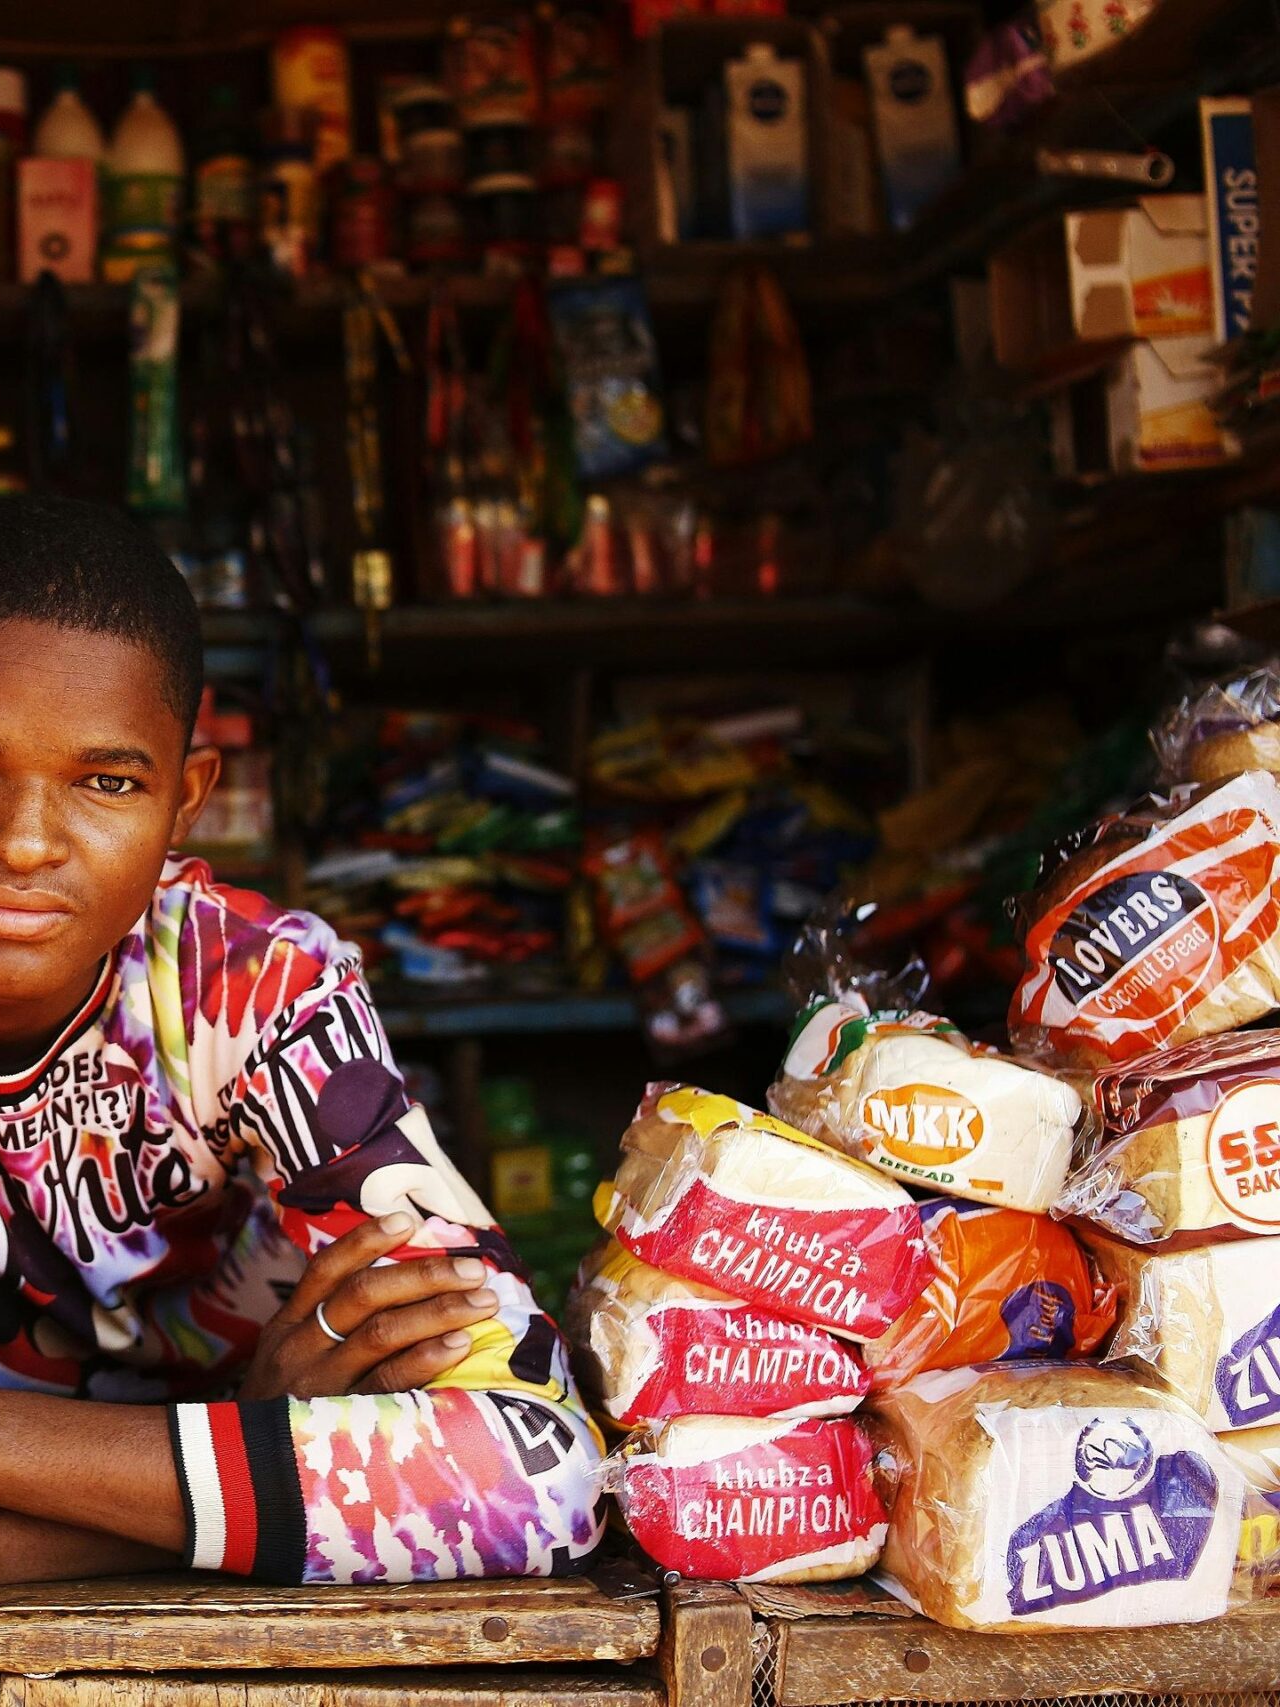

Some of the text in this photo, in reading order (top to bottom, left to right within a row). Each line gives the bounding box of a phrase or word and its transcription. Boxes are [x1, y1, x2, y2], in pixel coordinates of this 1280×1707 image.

[1222, 165, 1260, 281] SUPER
[1056, 874, 1183, 988] LOVERS
[1094, 919, 1210, 1015] Coconut Bread
[868, 1098, 979, 1150] MKK
[878, 1156, 956, 1185] BREAD
[1236, 1168, 1280, 1199] BAK
[745, 1208, 863, 1278] khubza
[690, 1229, 868, 1327] CHAMPION
[725, 1312, 838, 1344] khub
[684, 1343, 862, 1389] CHAMPION
[715, 1458, 834, 1490] khubza
[681, 1494, 852, 1541] CHAMPION
[1016, 1503, 1175, 1602] ZUMA
